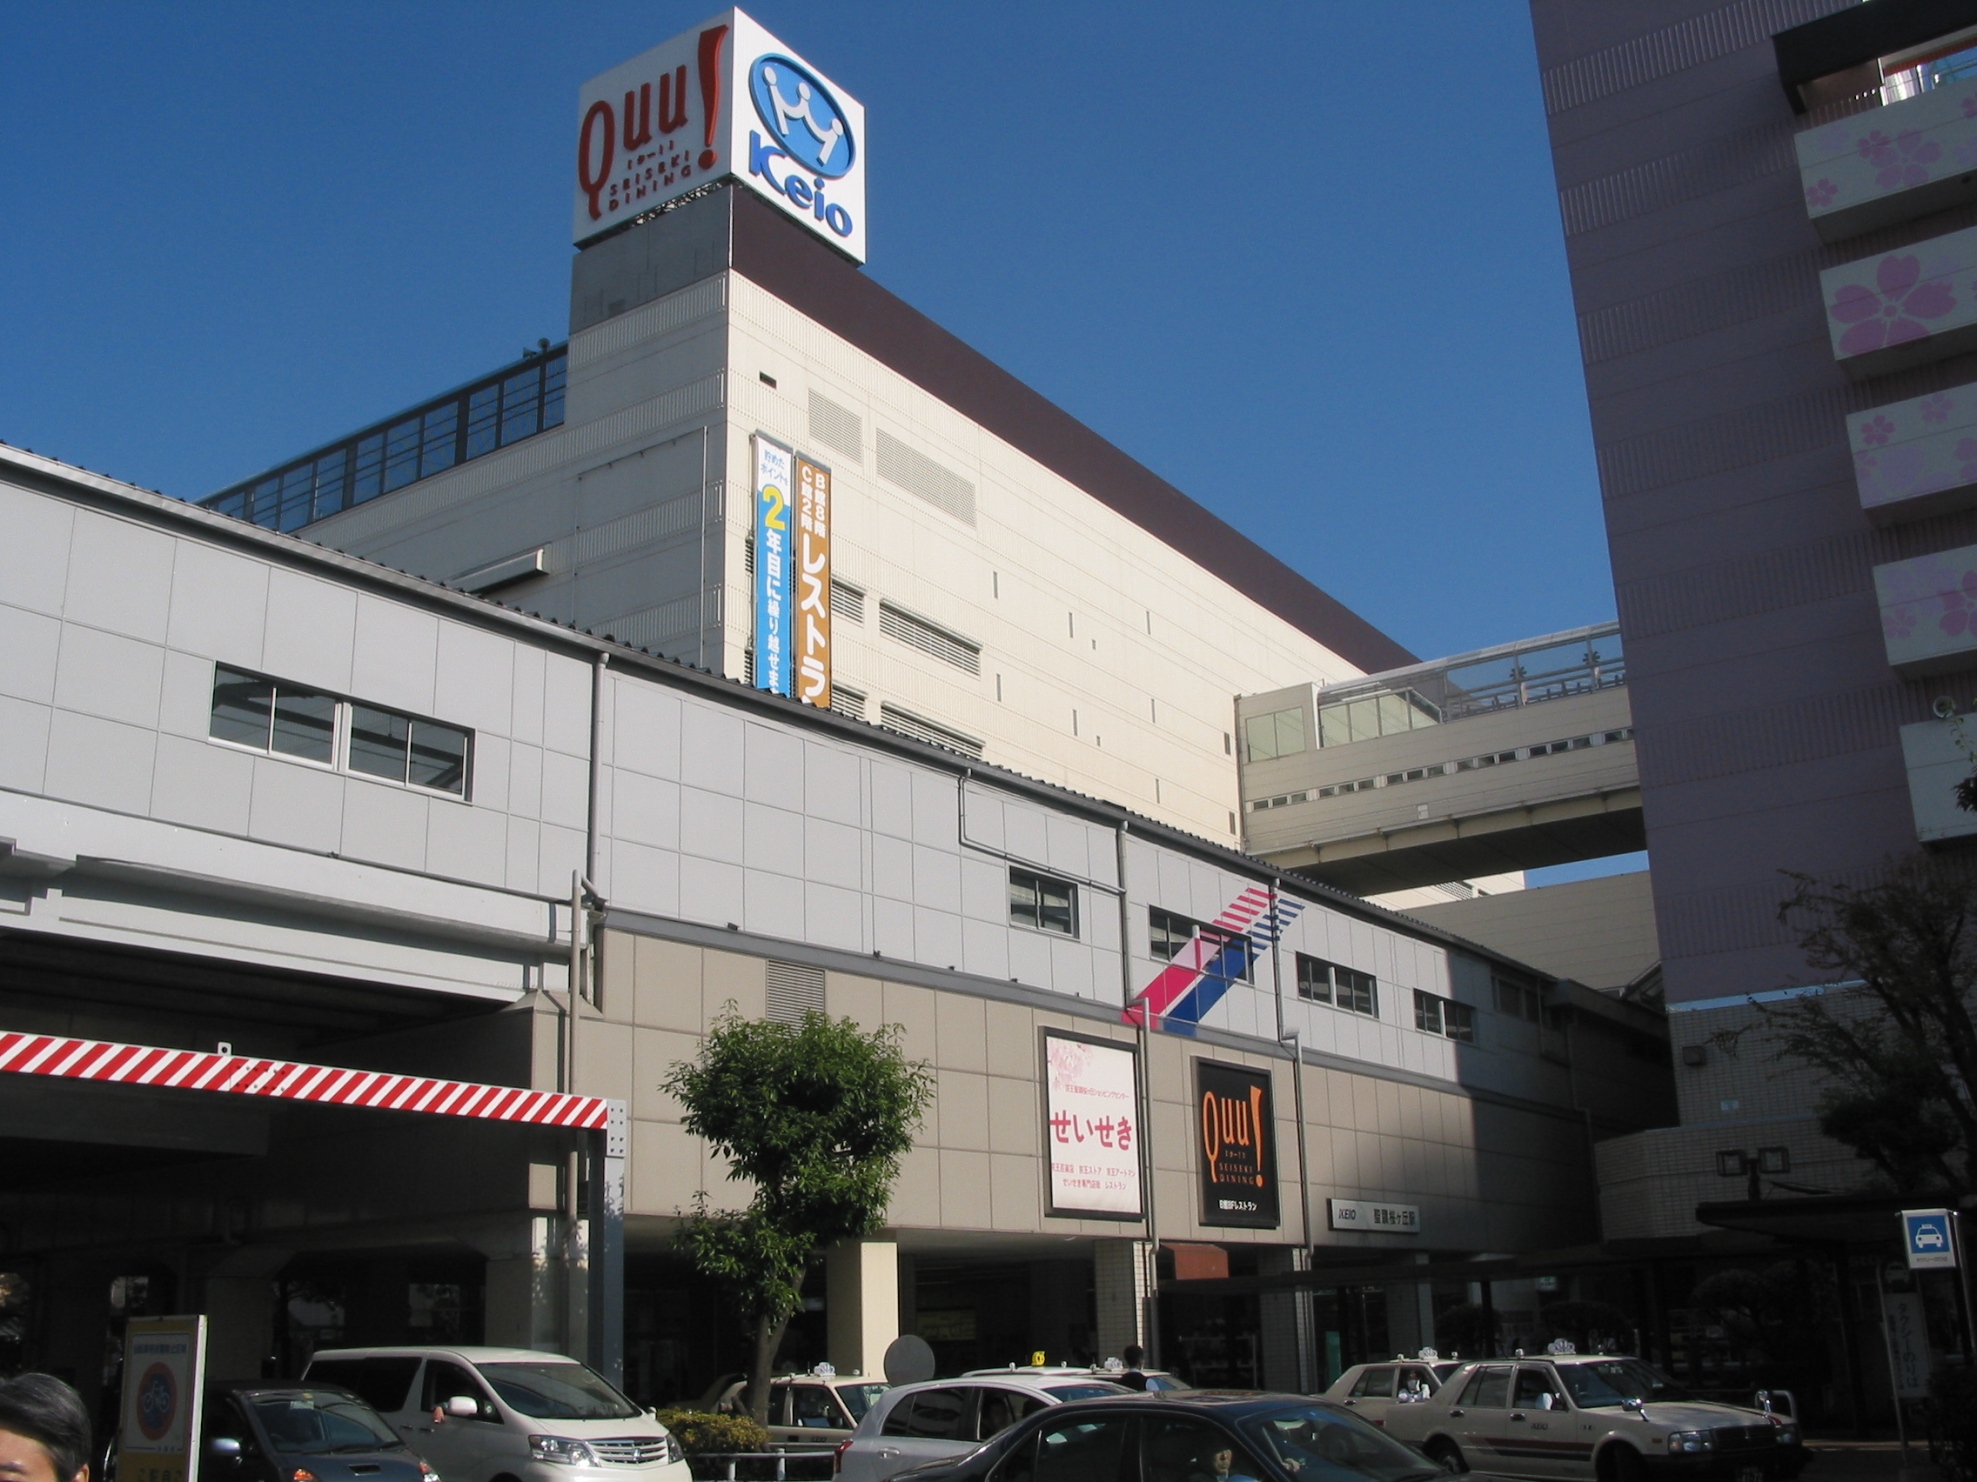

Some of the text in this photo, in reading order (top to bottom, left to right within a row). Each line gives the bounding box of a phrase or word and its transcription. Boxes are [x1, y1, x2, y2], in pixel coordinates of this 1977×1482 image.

[578, 24, 729, 220] Quu!
[608, 164, 692, 211] DINING
[609, 149, 690, 197] SEISEKI
[749, 130, 853, 237] Keio
[1050, 1110, 1132, 1151] せいせき
[1202, 1085, 1264, 1187] Quu!
[1105, 1181, 1127, 1191] レストラン
[1219, 1162, 1253, 1174] SEISEKI
[1219, 1174, 1255, 1185] DINING
